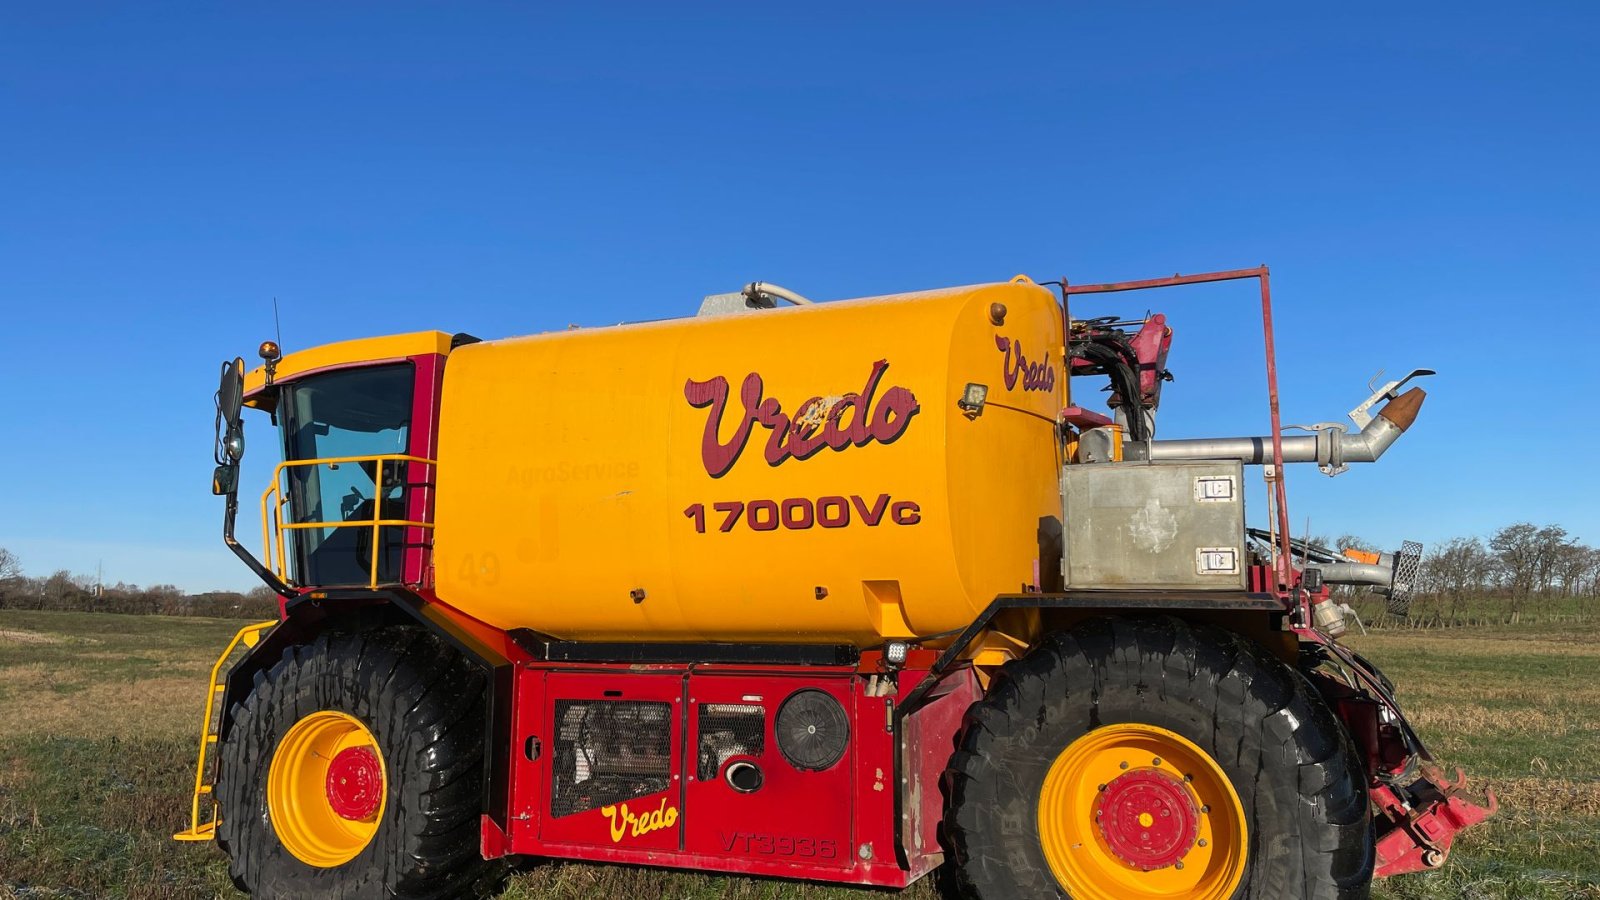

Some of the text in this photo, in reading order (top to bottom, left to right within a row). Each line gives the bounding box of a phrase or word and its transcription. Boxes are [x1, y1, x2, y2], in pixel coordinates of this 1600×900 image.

[995, 333, 1054, 393] Vredo
[684, 358, 920, 479] Vredo
[507, 461, 639, 489] AgroService
[683, 493, 921, 533] 17000Vc
[601, 797, 678, 842] Vredo
[720, 831, 837, 858] VT3936
